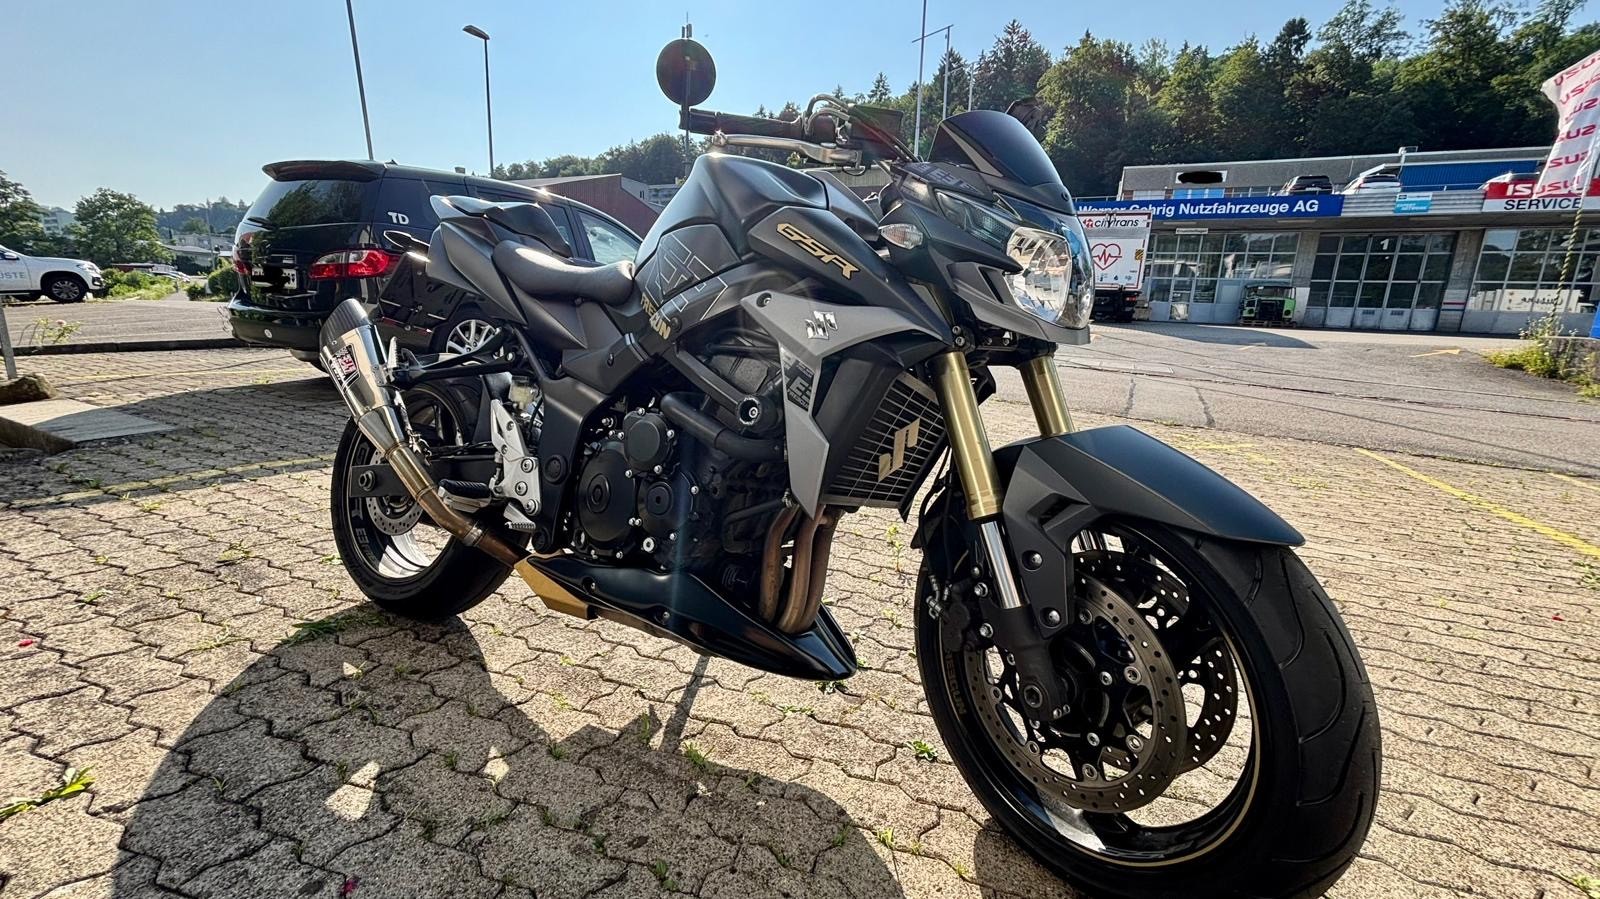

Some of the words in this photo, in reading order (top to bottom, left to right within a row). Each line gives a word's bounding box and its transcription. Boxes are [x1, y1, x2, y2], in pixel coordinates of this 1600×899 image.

[1179, 201, 1289, 216] Nutzfahrzeuge
[1293, 199, 1319, 213] AG
[1503, 197, 1582, 211] SERVICE
[387, 211, 410, 225] TD
[777, 222, 860, 280] GSR
[1380, 238, 1390, 250] 1
